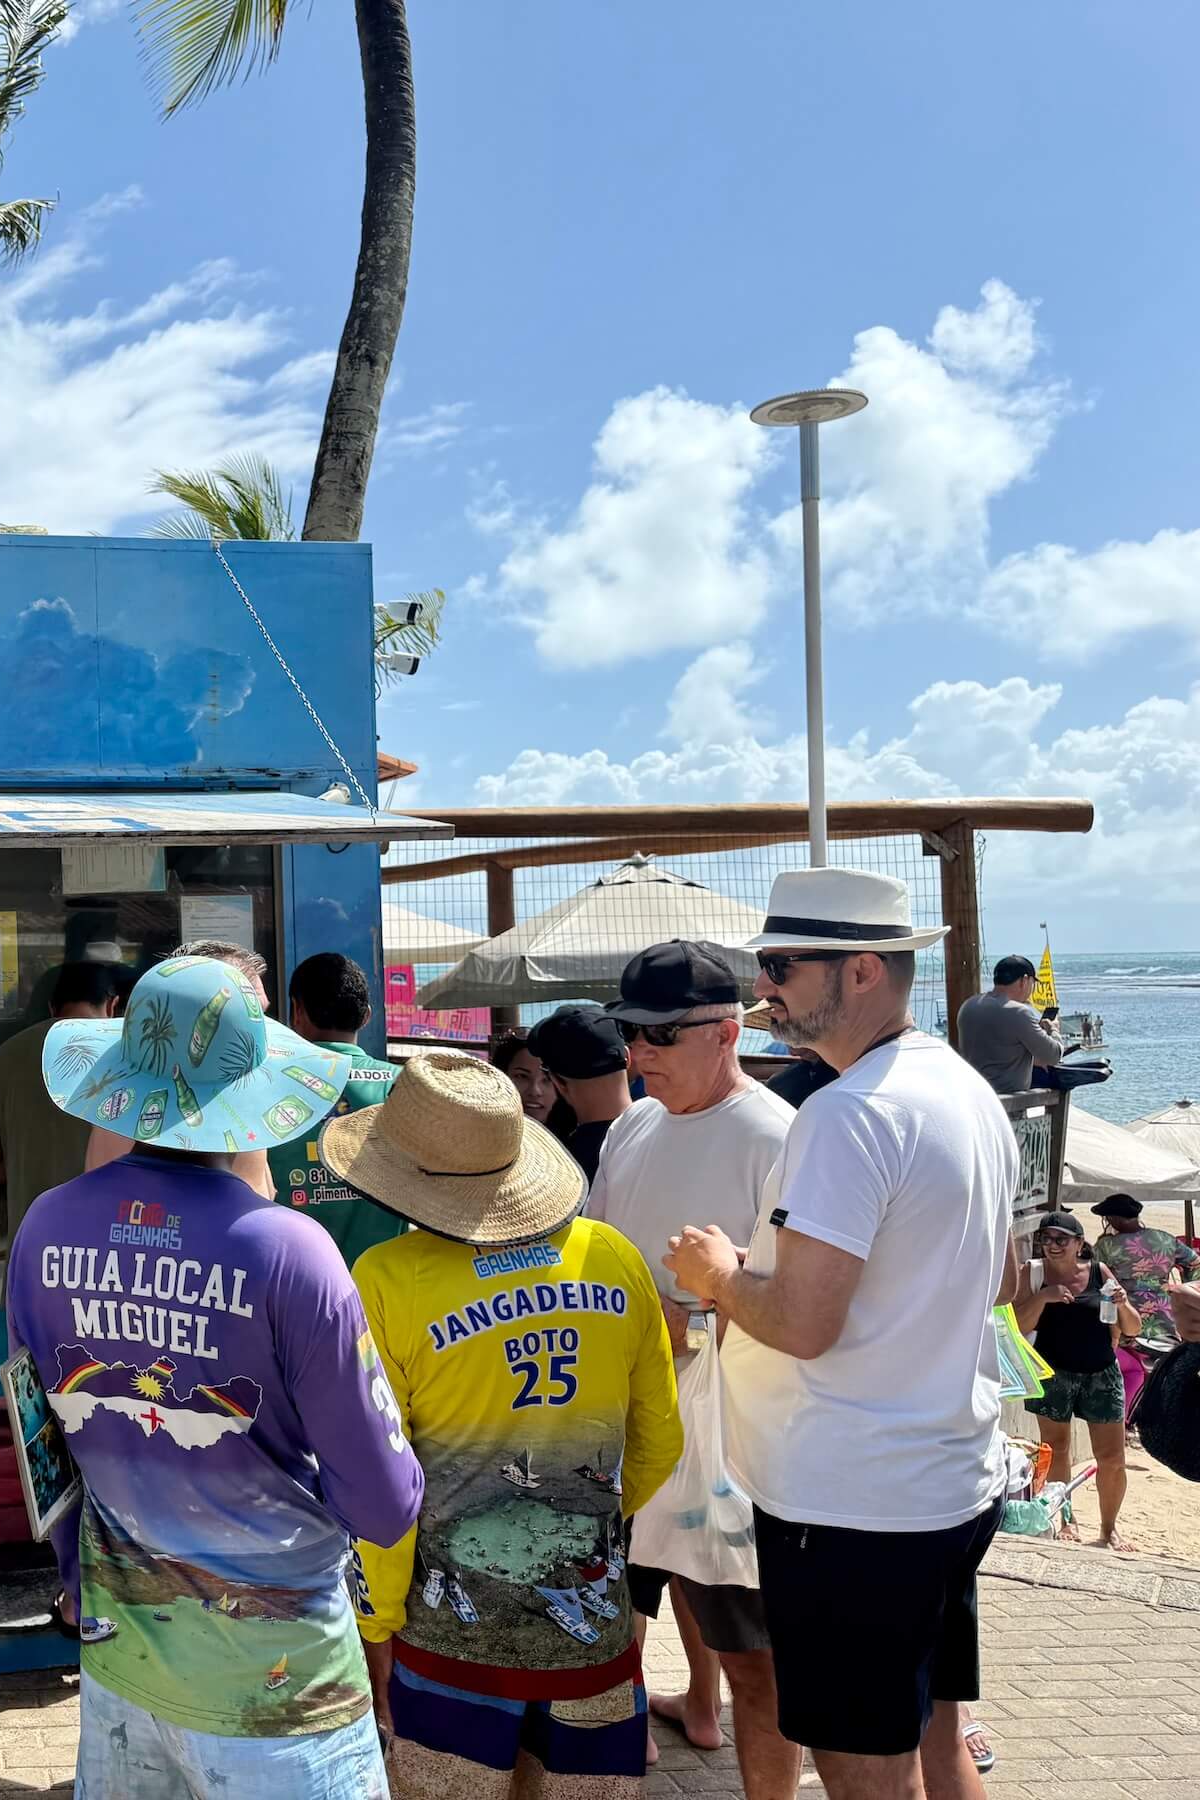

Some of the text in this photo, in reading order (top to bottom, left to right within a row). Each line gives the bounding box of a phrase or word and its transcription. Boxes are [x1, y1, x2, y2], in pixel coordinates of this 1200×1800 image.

[109, 1222, 183, 1250] GALINHAS
[166, 1214, 182, 1229] DE
[41, 1245, 255, 1319] GUIA LOCAL
[472, 1243, 563, 1279] GALINHAS
[70, 1297, 220, 1360] MIGUEL
[427, 1281, 628, 1351] JANGADEIRO
[503, 1327, 581, 1364] BOTO
[510, 1353, 580, 1411] 25
